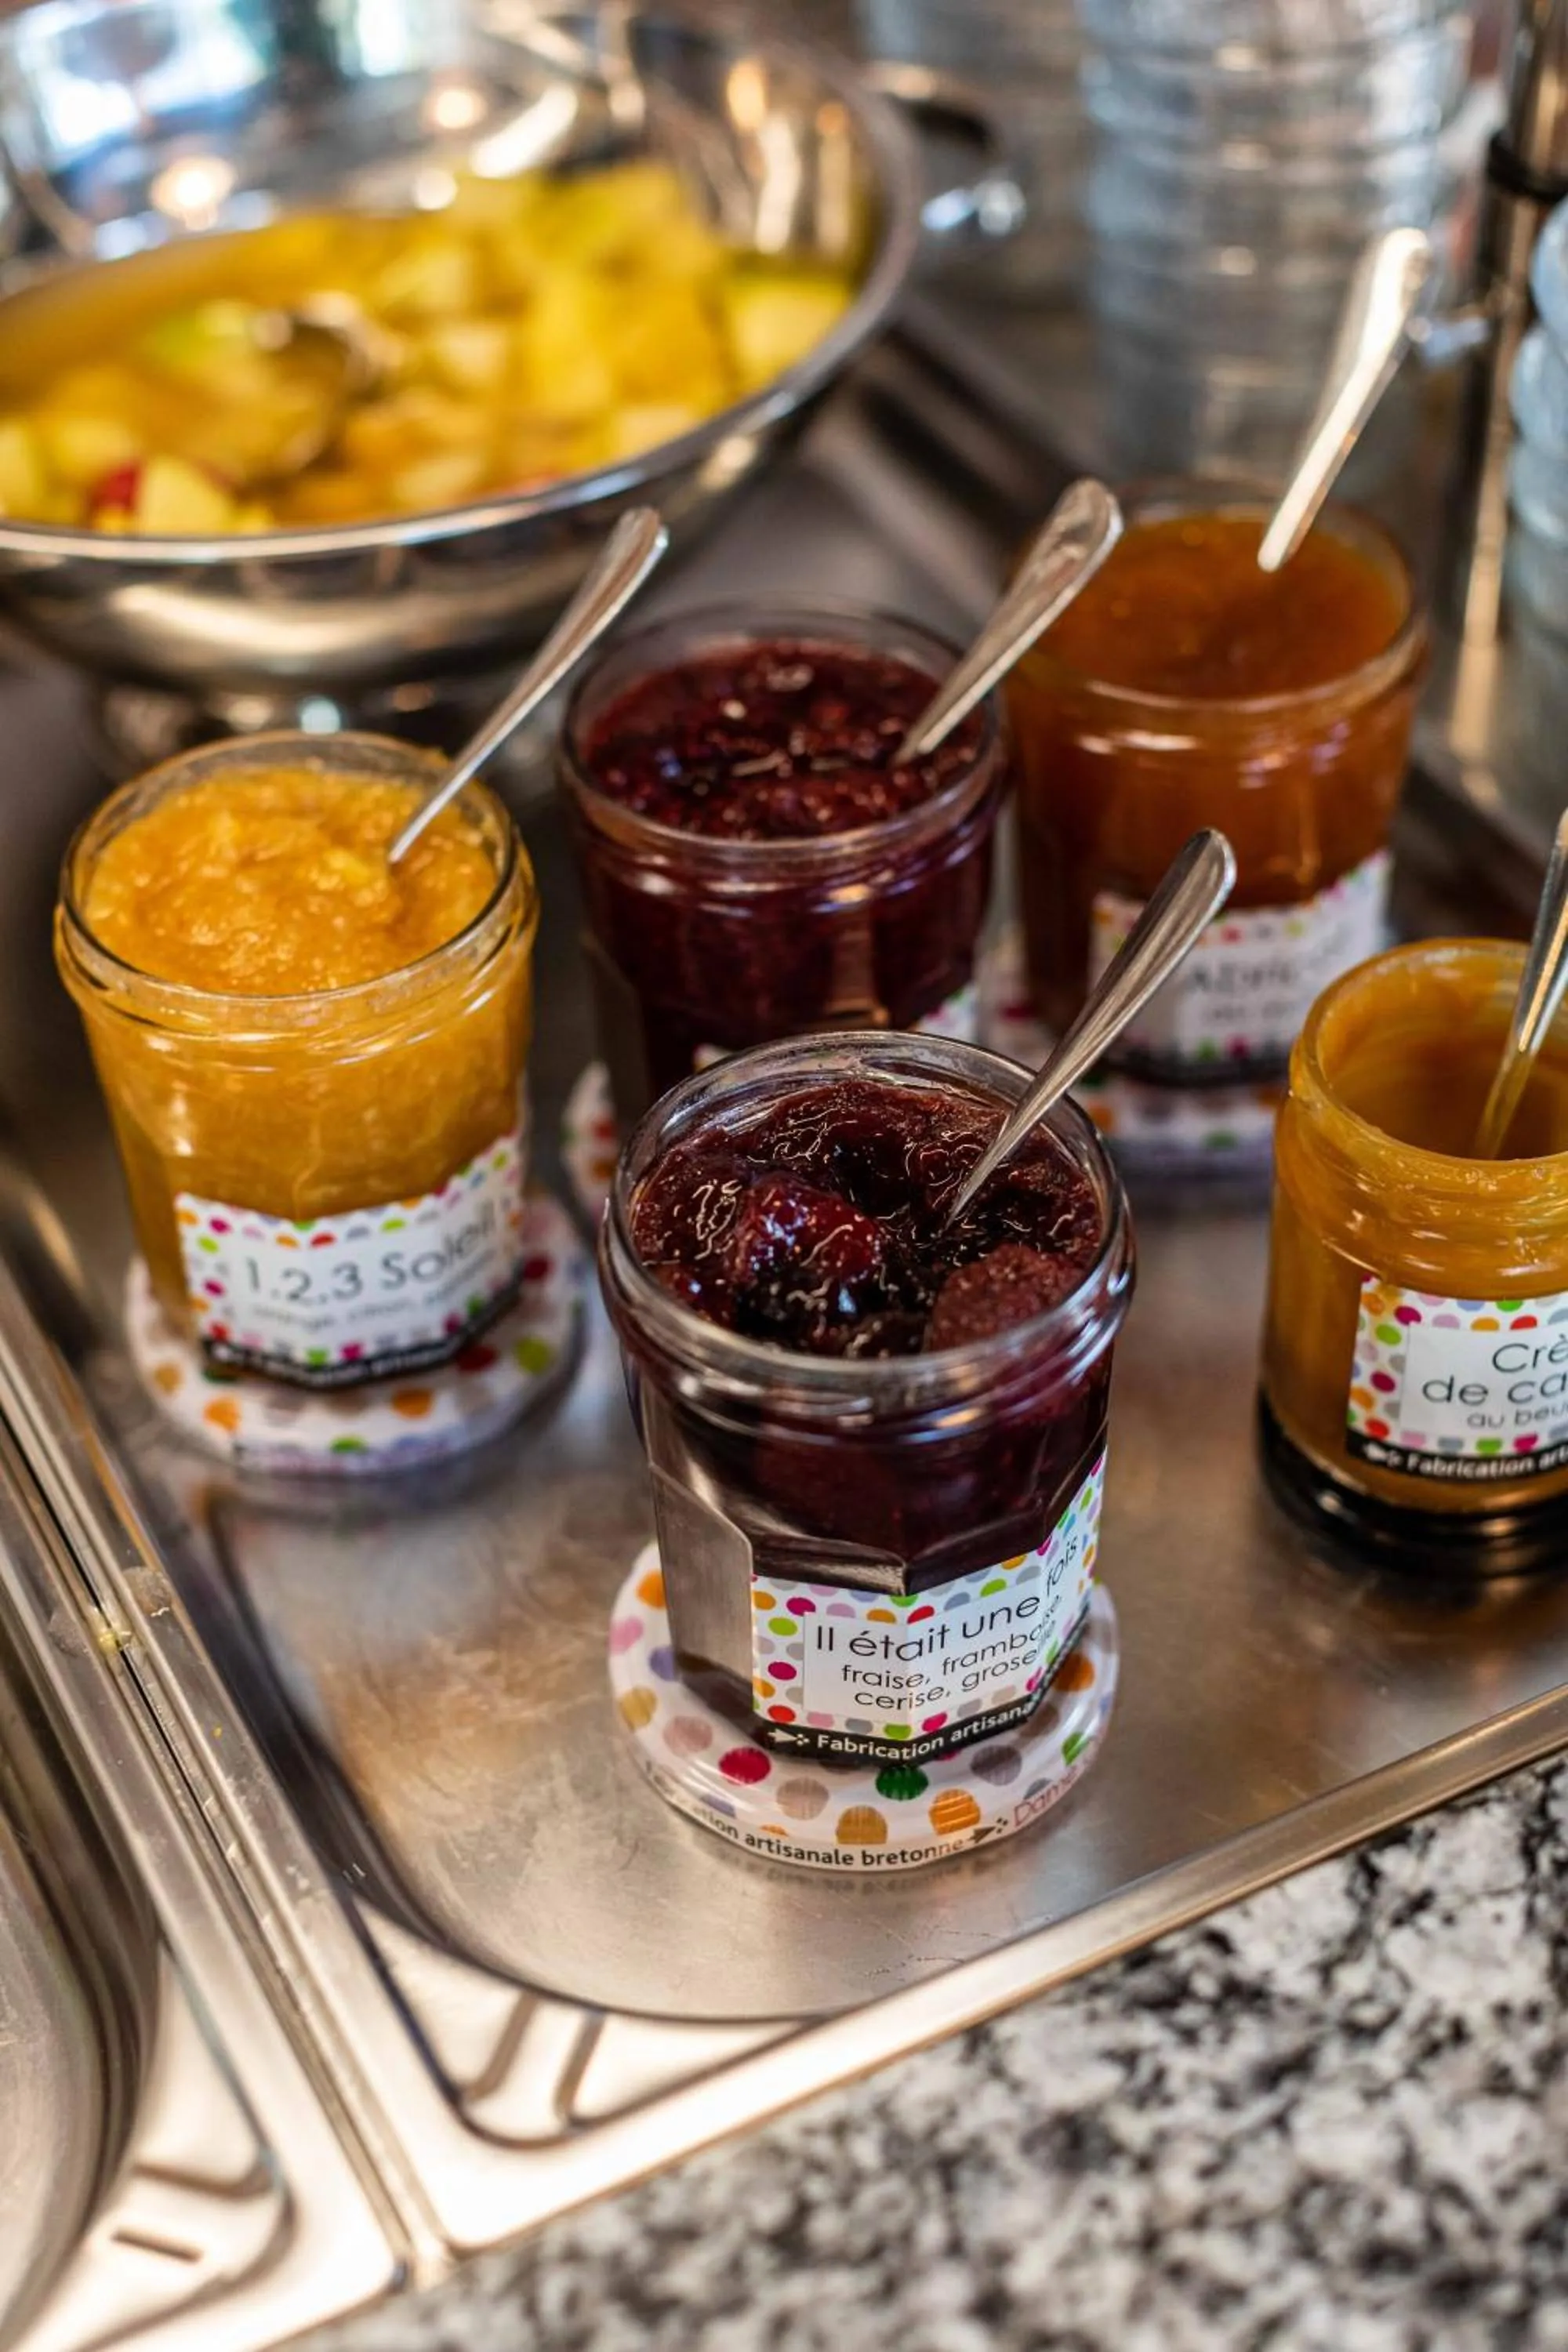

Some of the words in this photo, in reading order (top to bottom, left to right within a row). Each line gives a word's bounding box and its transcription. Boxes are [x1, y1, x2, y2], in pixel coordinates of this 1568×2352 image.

[246, 1256, 364, 1305] 1.2.3
[1492, 1333, 1568, 1373] Crè
[1422, 1374, 1489, 1406] de
[1507, 1372, 1568, 1404] ca
[1467, 1413, 1504, 1429] au
[1407, 1454, 1535, 1479] Fabrication
[1539, 1444, 1568, 1469] art
[817, 1624, 833, 1652] Il
[849, 1624, 949, 1661] était
[962, 1595, 1040, 1639] une
[1047, 1535, 1079, 1597] fois
[841, 1664, 931, 1690] fraise,
[854, 1685, 953, 1711] cerise,
[816, 1734, 945, 1761] Fabrication
[744, 1833, 855, 1867] artisanale
[862, 1838, 964, 1867] bretonne
